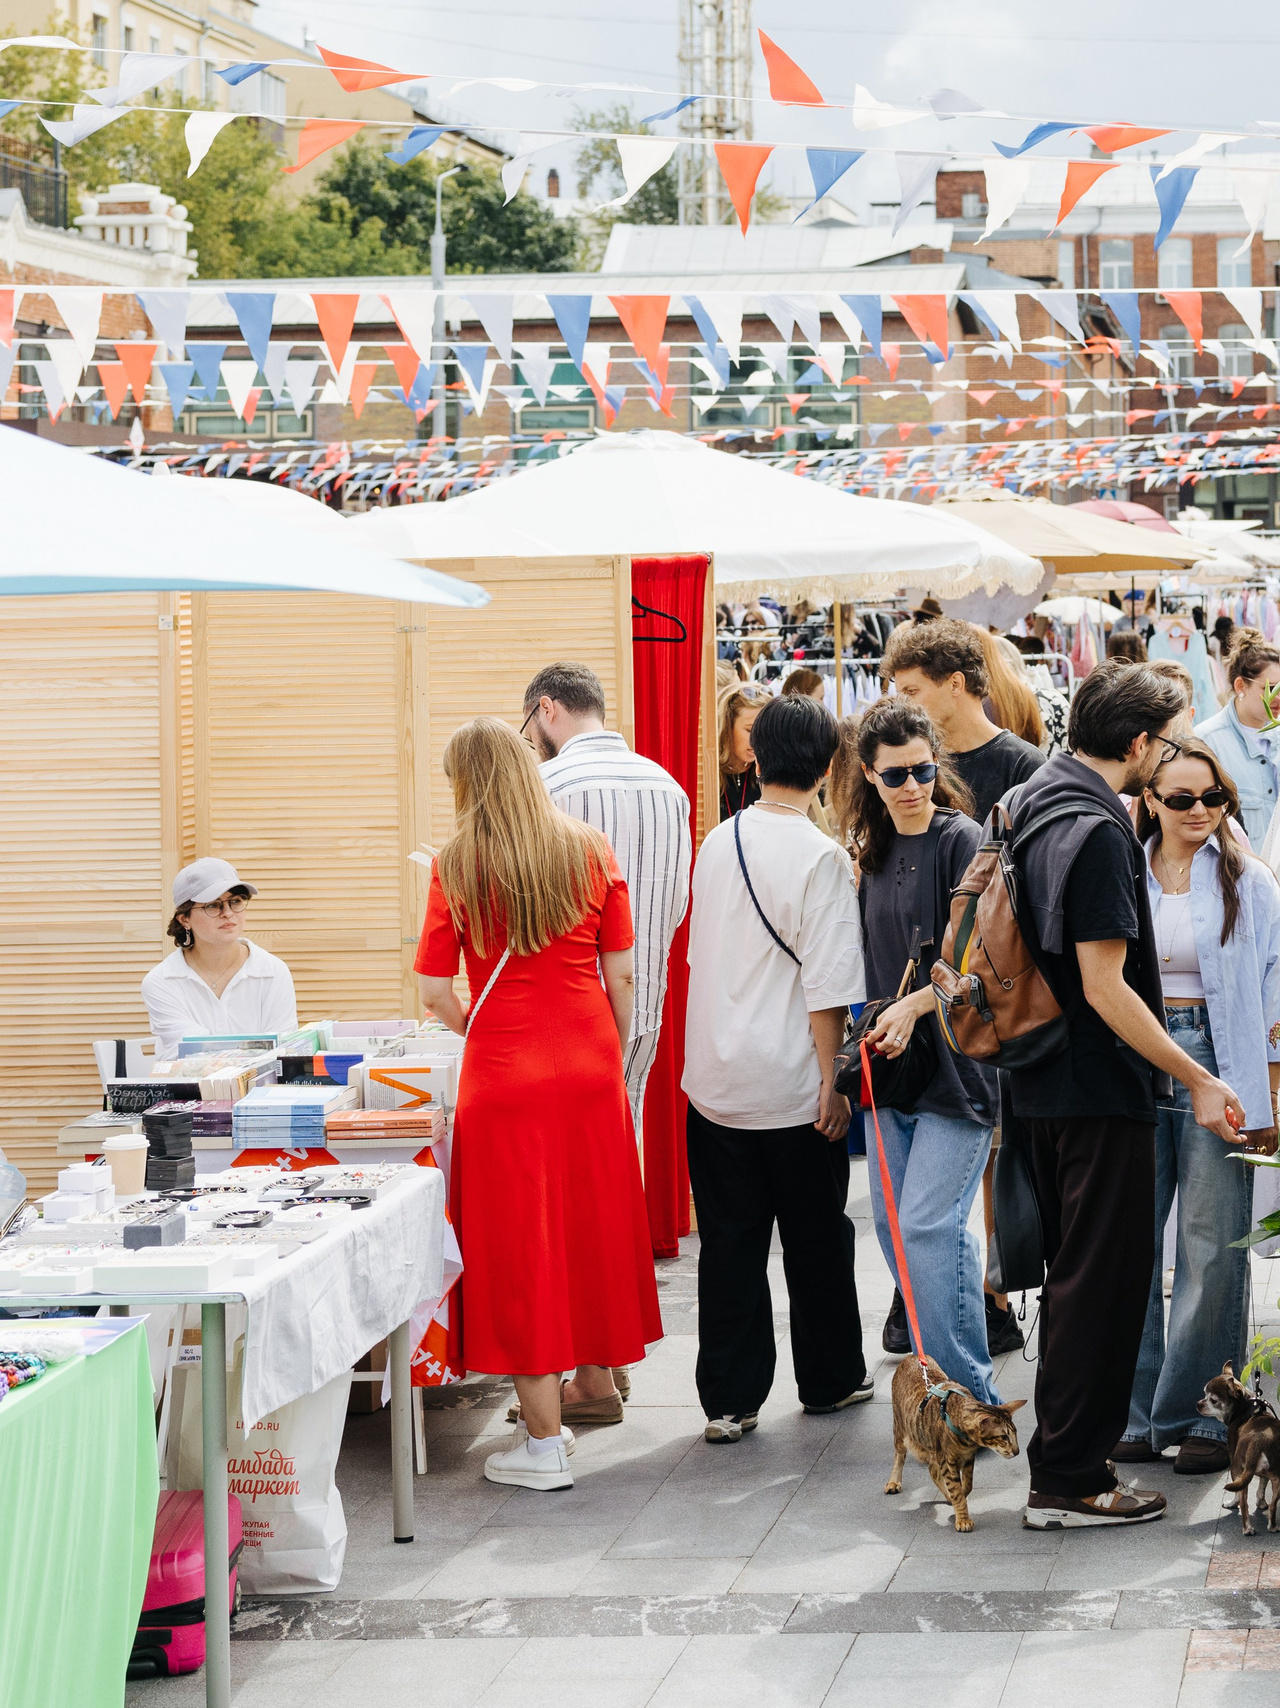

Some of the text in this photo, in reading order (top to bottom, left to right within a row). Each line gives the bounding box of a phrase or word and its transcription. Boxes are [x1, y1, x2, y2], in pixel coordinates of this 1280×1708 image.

[236, 1420, 280, 1432] LD.RU
[227, 1448, 296, 1476] амбада
[228, 1478, 302, 1504] маркет
